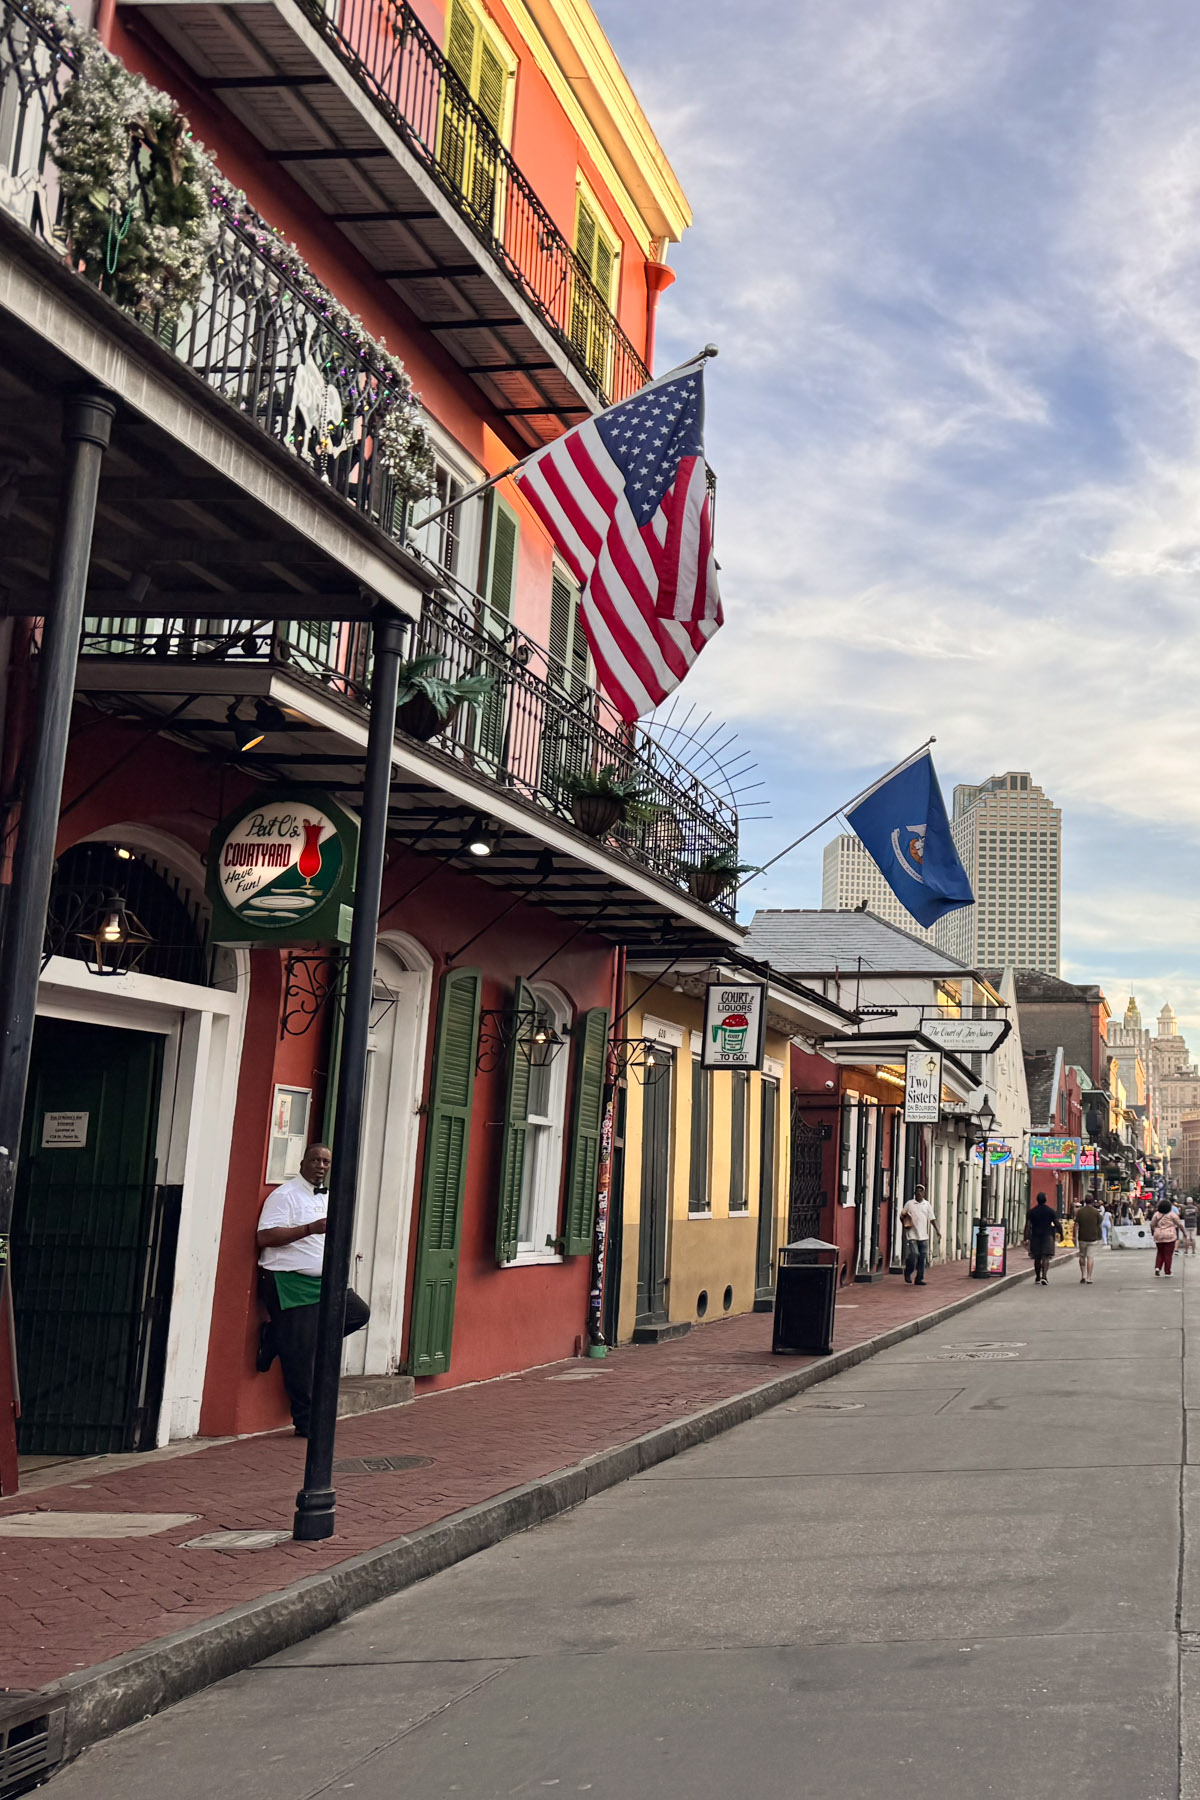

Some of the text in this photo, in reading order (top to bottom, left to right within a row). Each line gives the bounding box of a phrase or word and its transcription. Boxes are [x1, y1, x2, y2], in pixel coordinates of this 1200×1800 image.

[246, 814, 278, 837] Pat
[224, 843, 291, 867] COURTYARD
[225, 868, 253, 884] Have
[235, 875, 261, 893] Fun!
[721, 991, 749, 1004] COURT
[718, 1004, 752, 1012] LIQUORS
[929, 1026, 939, 1036] The
[909, 1075, 928, 1088] Two
[908, 1090, 937, 1104] Sisters
[1032, 1138, 1076, 1146] TROPICAL
